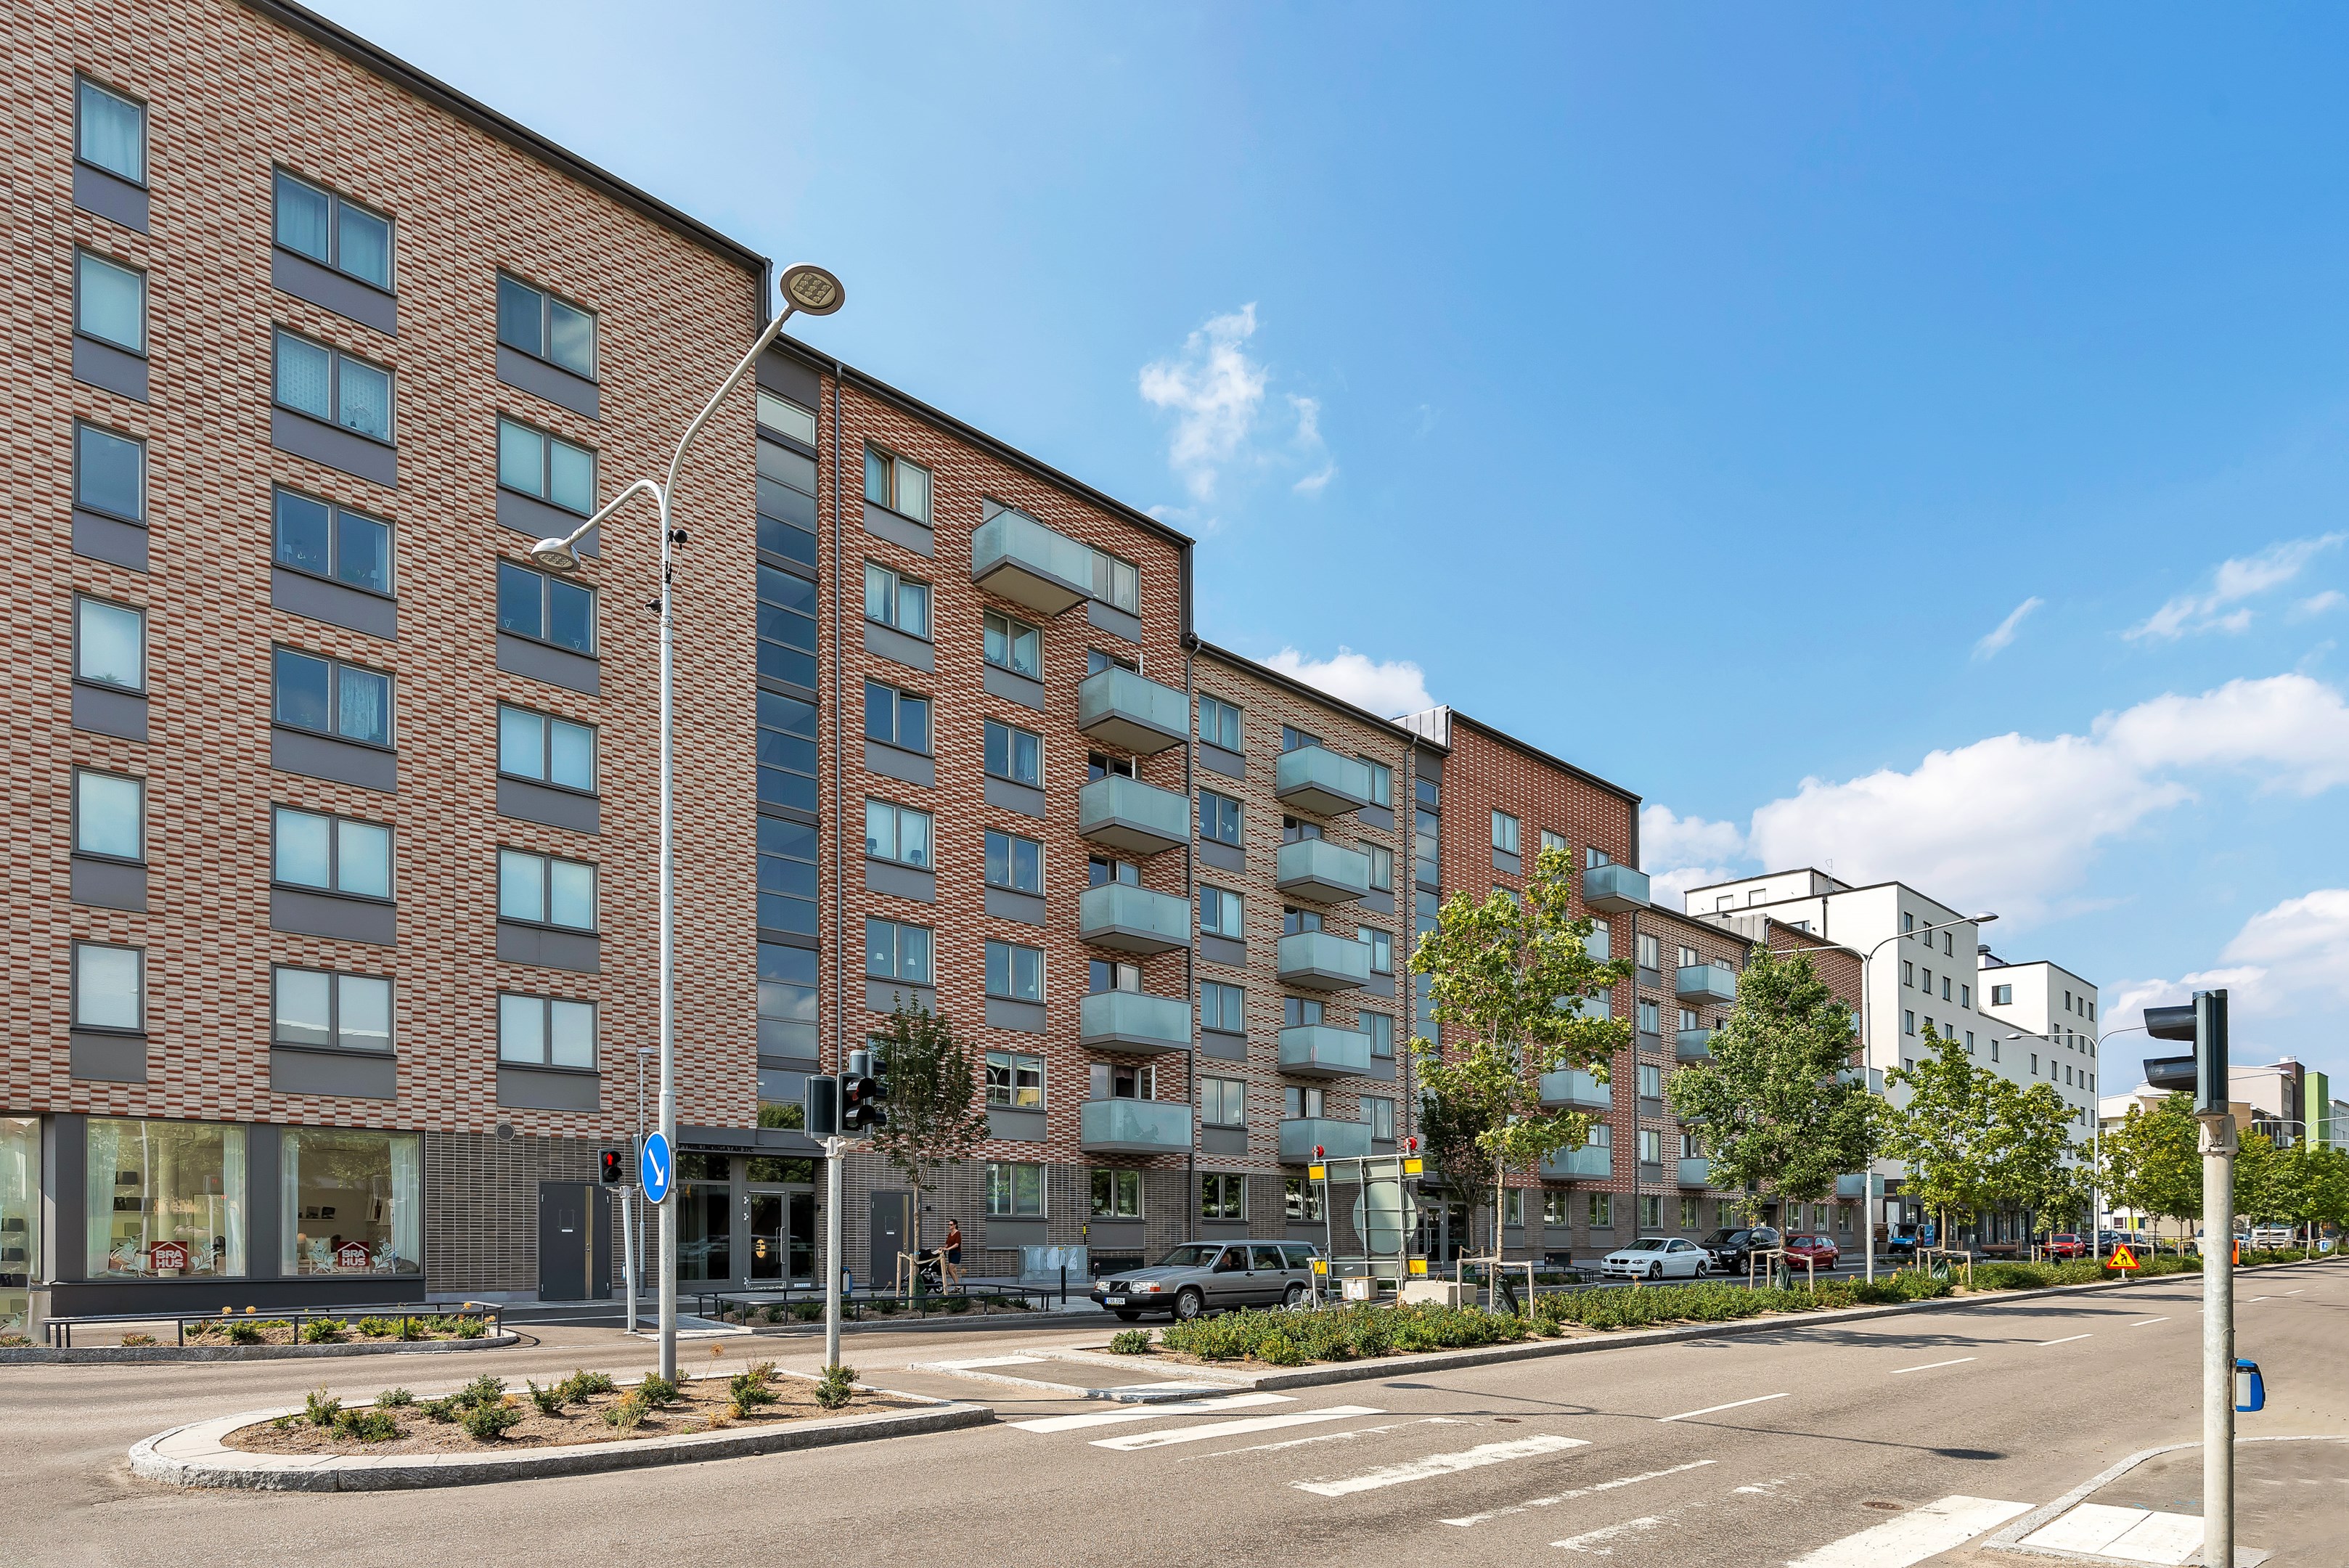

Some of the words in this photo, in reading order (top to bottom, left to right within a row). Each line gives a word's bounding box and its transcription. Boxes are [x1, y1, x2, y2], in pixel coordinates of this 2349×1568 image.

[156, 1250, 184, 1259] BRA
[342, 1249, 366, 1258] BRA
[156, 1259, 184, 1268] HUS
[342, 1257, 366, 1266] HUS
